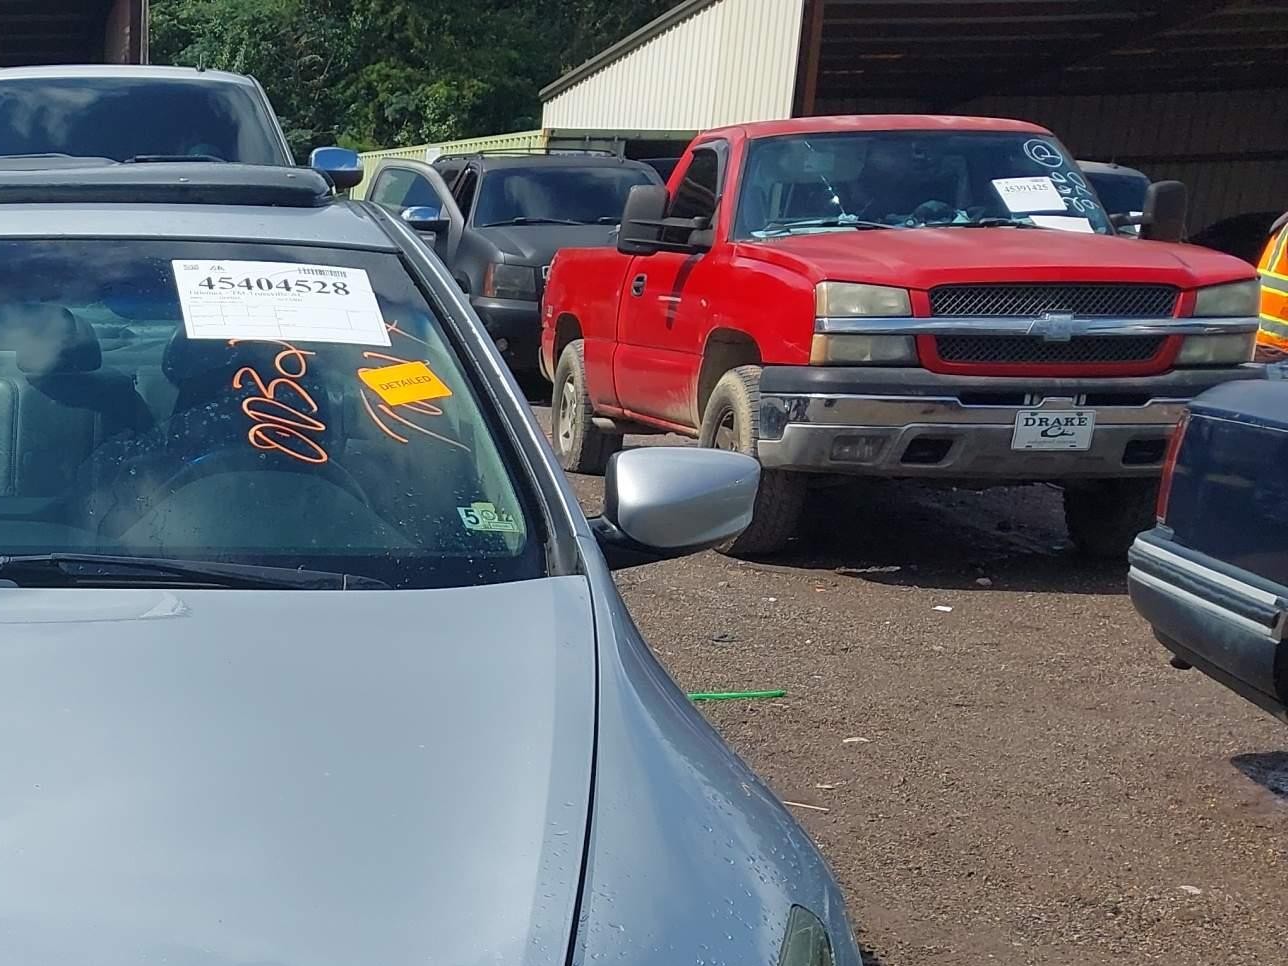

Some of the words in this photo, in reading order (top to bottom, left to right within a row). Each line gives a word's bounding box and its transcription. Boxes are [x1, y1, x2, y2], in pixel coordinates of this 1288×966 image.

[198, 276, 351, 296] 45404528
[380, 374, 432, 392] DETAILED
[1023, 417, 1088, 427] DRAKE
[464, 508, 480, 525] 5
